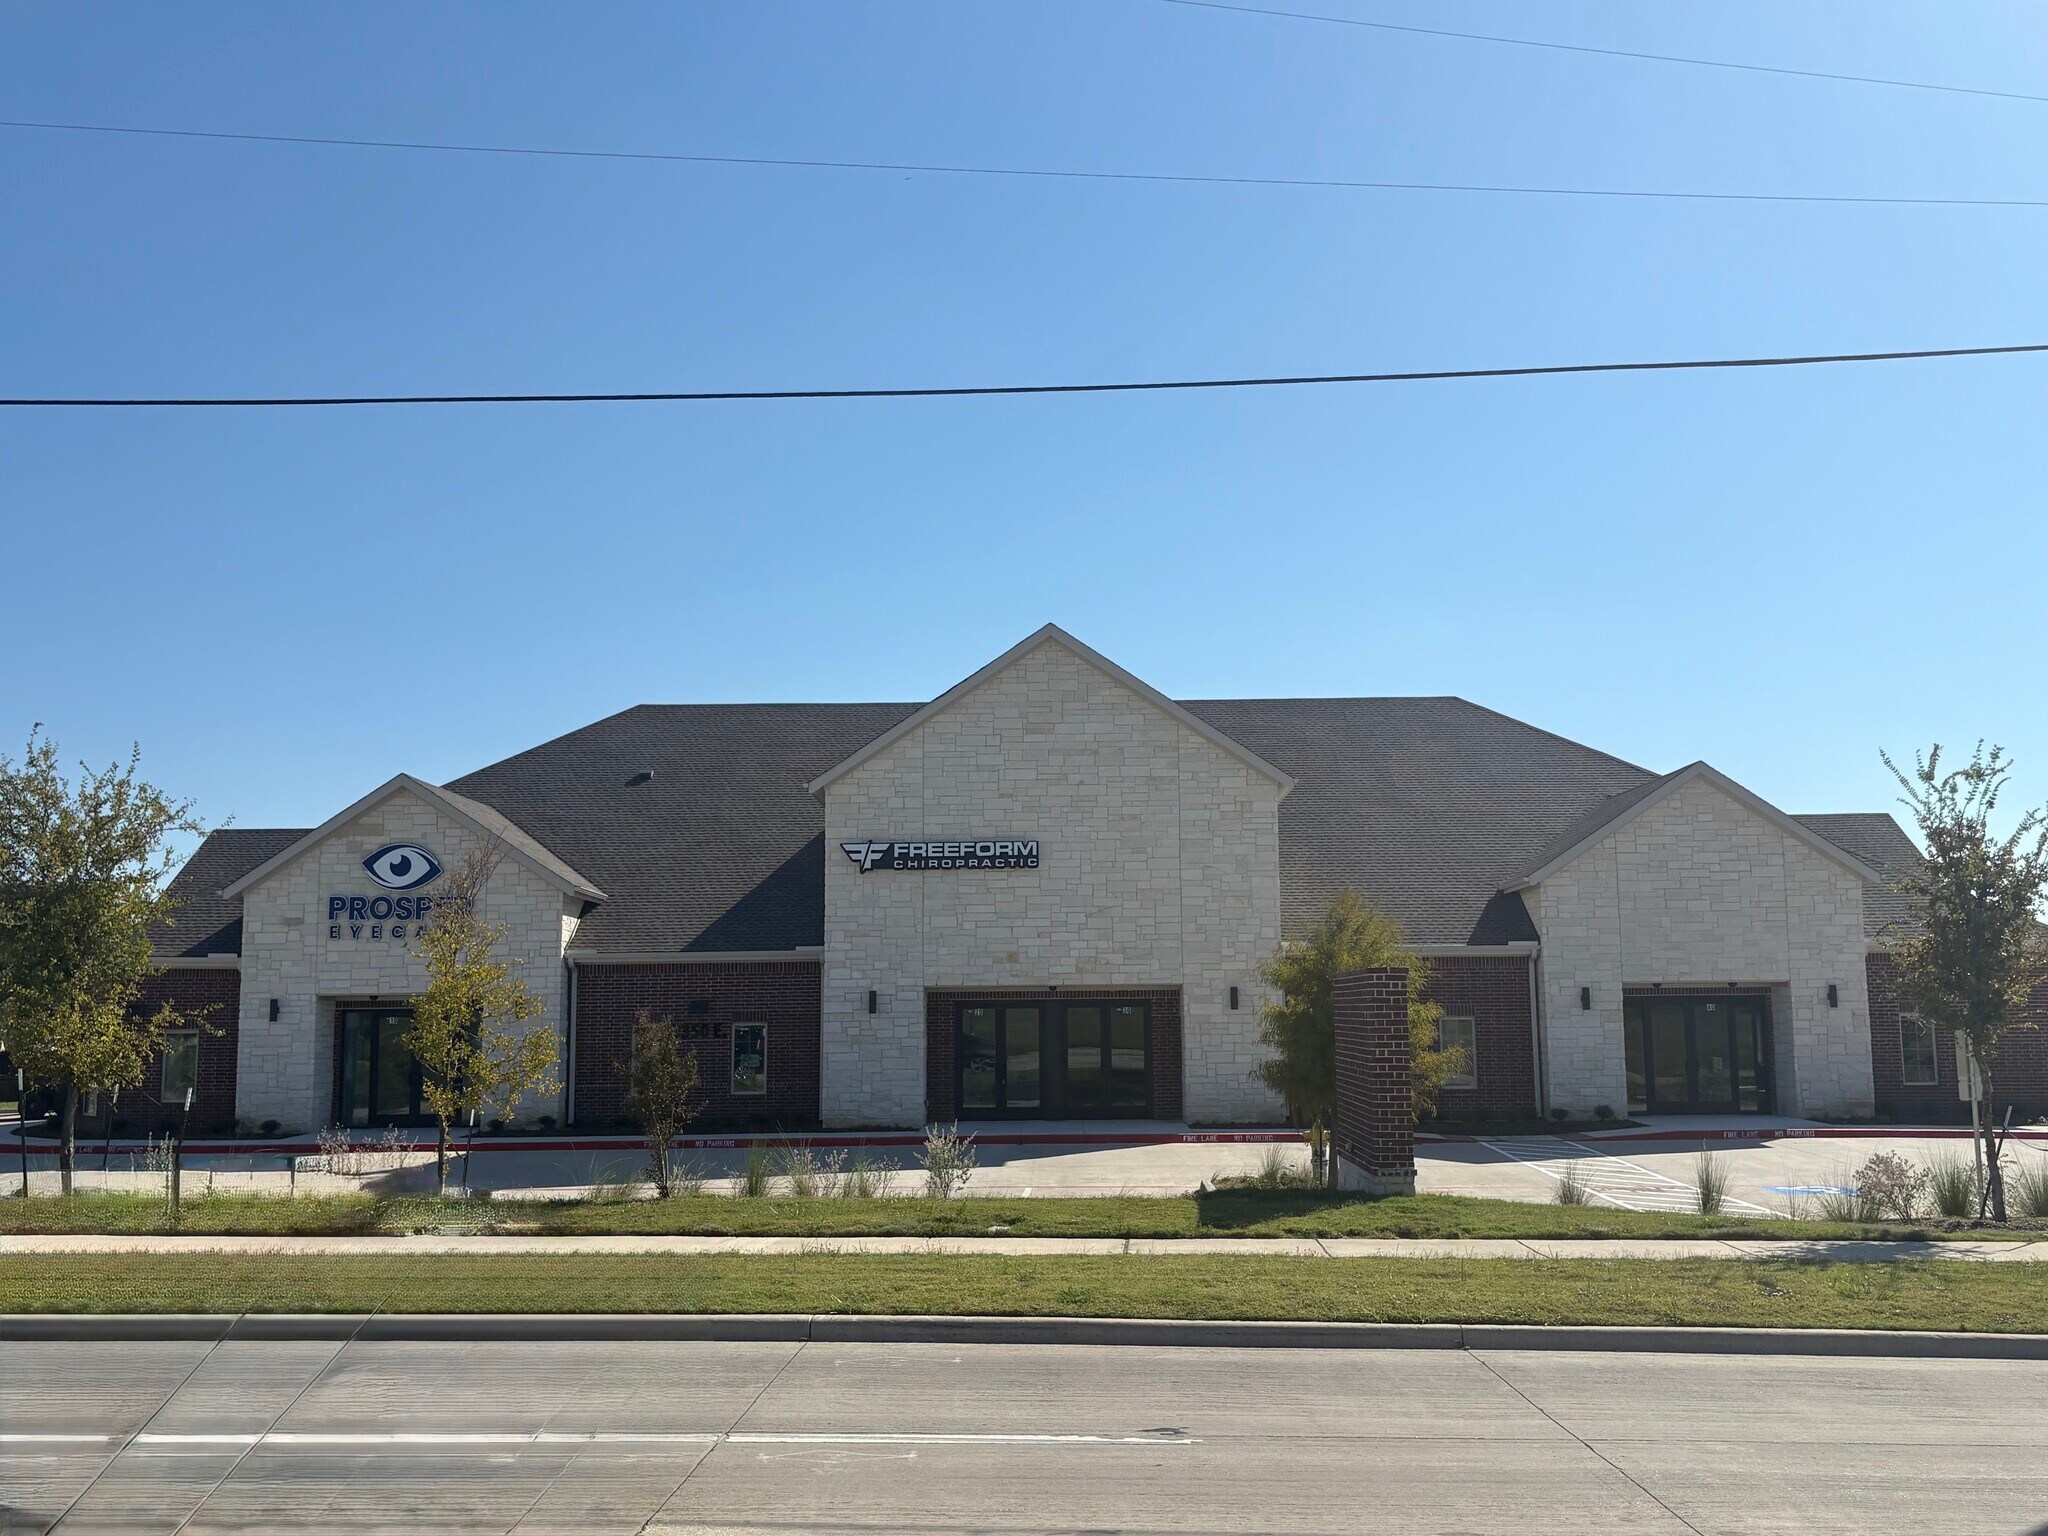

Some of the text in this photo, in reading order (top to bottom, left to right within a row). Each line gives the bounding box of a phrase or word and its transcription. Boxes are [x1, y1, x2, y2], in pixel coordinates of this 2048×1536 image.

[894, 841, 1037, 858] FREEFORM
[894, 859, 1037, 869] CHIROPRACTIC
[328, 895, 474, 922] PROSP
[1723, 1131, 1738, 1139] FIRE
[695, 1140, 704, 1148] NO
